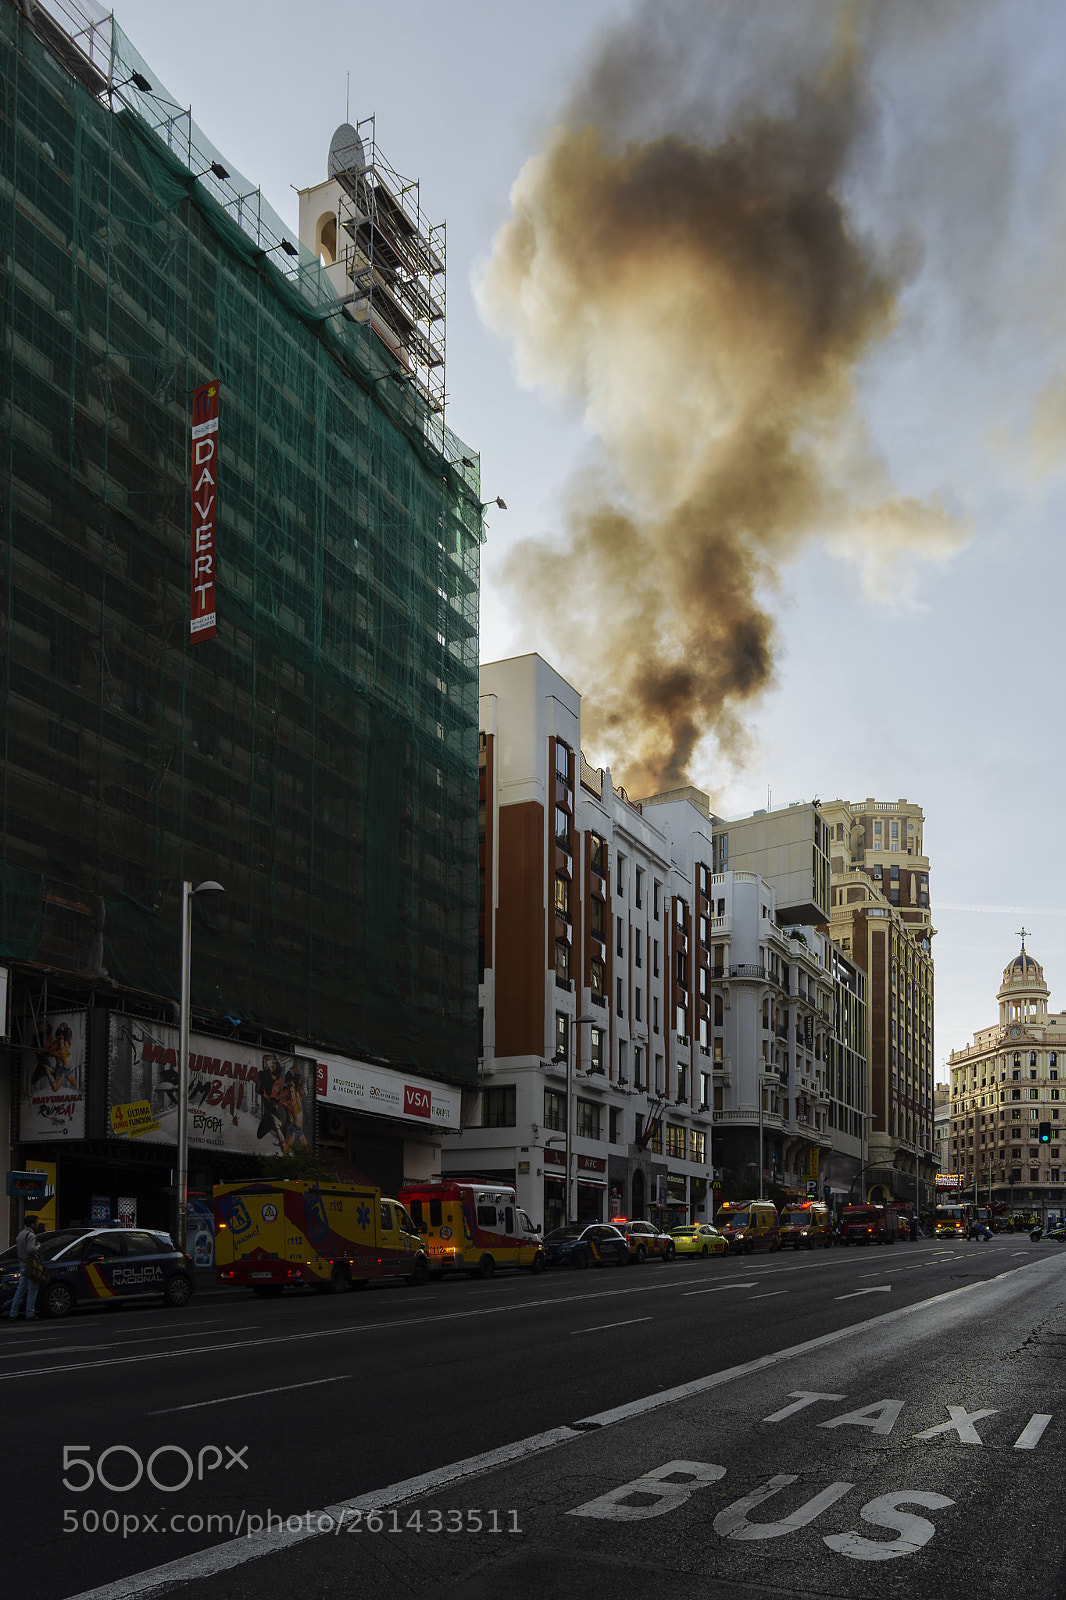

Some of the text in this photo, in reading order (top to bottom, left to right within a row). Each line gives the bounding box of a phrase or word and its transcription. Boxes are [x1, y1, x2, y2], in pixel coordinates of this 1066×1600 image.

[194, 438, 215, 610] DAVERT
[142, 1043, 258, 1084] MAUMANA
[32, 1094, 82, 1104] MAYUMANA
[406, 1090, 429, 1109] VSA
[116, 1107, 123, 1121] 4
[193, 1115, 224, 1135] ESTOPA
[584, 1159, 597, 1169] KFC
[806, 1180, 817, 1192] P
[112, 1274, 163, 1286] NACIONAL
[761, 1390, 1053, 1449] TAXI
[564, 1459, 956, 1561] BUS
